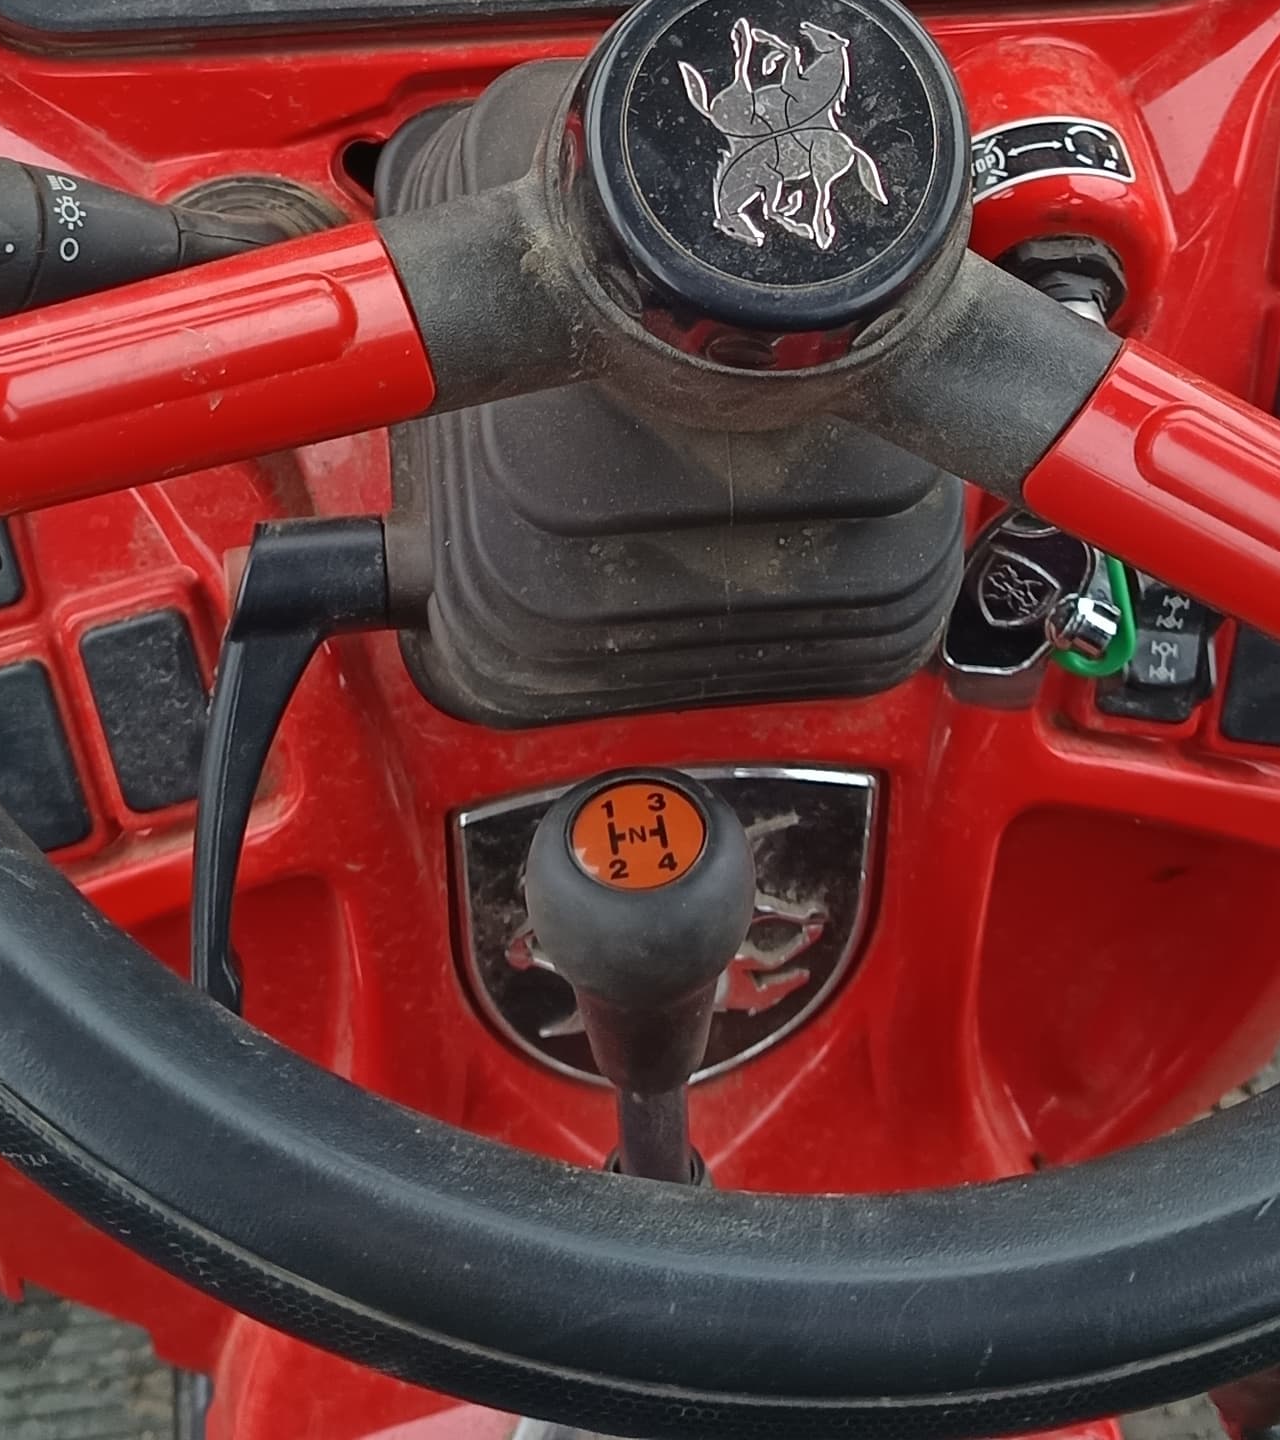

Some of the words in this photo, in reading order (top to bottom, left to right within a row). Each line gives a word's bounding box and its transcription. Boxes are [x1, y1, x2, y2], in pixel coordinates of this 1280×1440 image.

[601, 799, 614, 819] 1
[647, 792, 667, 812] 3
[628, 825, 647, 844] N
[609, 859, 629, 880] 2
[657, 852, 678, 872] 4
